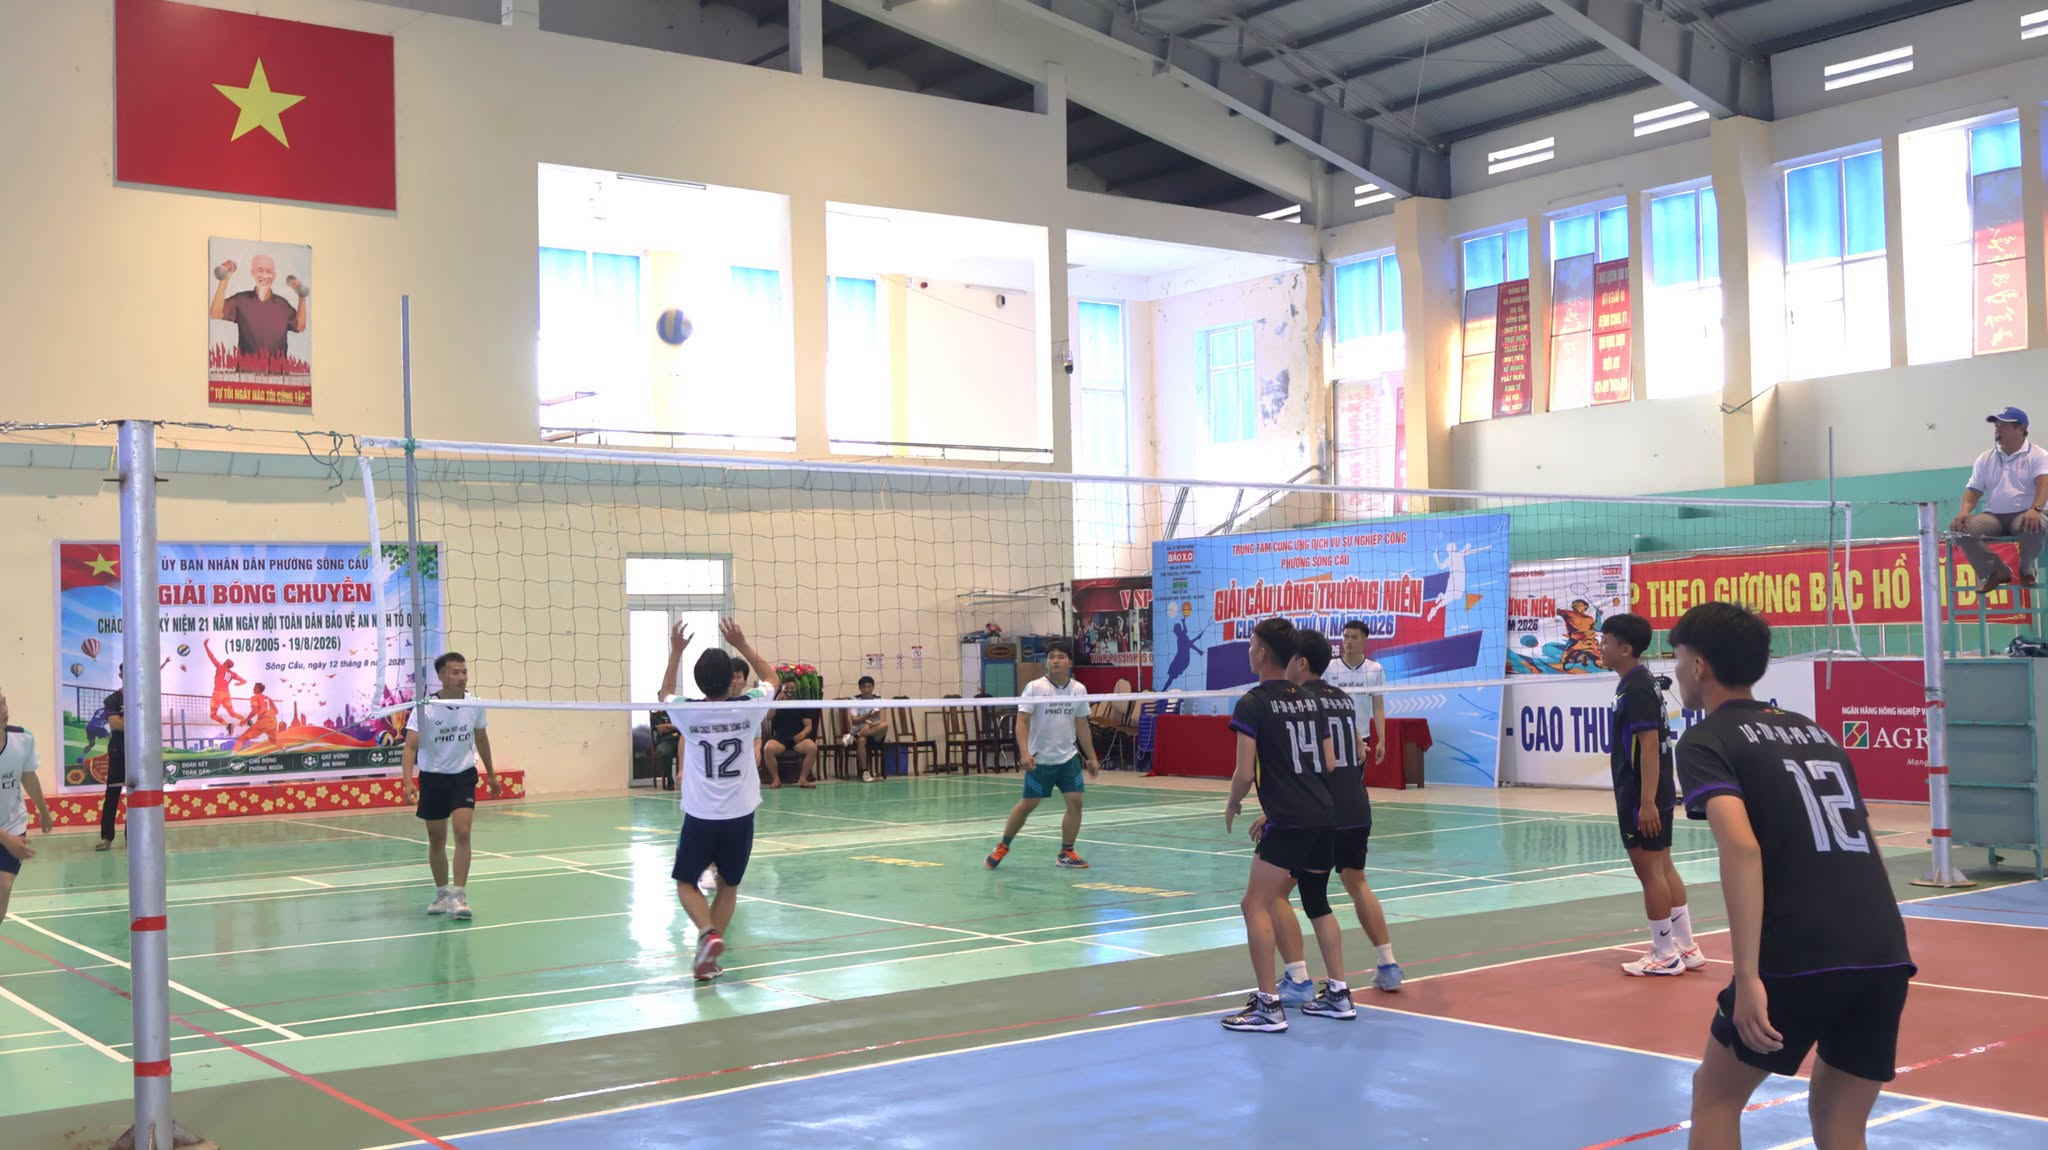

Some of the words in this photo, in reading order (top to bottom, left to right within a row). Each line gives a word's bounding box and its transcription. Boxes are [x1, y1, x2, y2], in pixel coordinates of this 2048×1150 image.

[235, 386, 251, 400] NGÀY
[1232, 543, 1254, 556] TRUNG
[1273, 540, 1292, 552] CUNG
[1354, 532, 1383, 547] NGHIỆP
[1384, 531, 1406, 544] CÔNG
[162, 556, 176, 570] ỦY
[181, 559, 203, 570] BAN
[208, 556, 238, 570] NHÂN
[243, 556, 265, 570] DÂN
[270, 556, 312, 570] PHƯỜNG
[316, 556, 344, 570] SÔNG
[348, 556, 368, 570] CẦU
[158, 578, 206, 606] GIẢI
[212, 580, 276, 605] BÓNG
[283, 576, 372, 604] CHUYỀN
[1214, 578, 1242, 622] GIẢI
[1245, 578, 1273, 616] CẦU
[1276, 580, 1315, 613] LÔNG
[1318, 576, 1379, 612] THƯỜNG
[1382, 572, 1424, 616] NIÊN
[1647, 578, 1706, 618] THEO
[1714, 571, 1801, 614] GƯƠNG
[1809, 562, 1864, 612] BÁC
[1872, 553, 1911, 609] HỒ
[1531, 594, 1555, 618] NIÊN
[172, 614, 196, 635] NIỆM
[200, 617, 209, 632] 21
[213, 613, 233, 631] NĂM
[236, 613, 259, 631] NGÀY
[262, 612, 276, 633] HỘI
[280, 612, 302, 630] TOÀN
[305, 612, 322, 630] DÂN
[326, 610, 342, 629] BẢO
[345, 612, 355, 631] VỆ
[358, 614, 369, 628] AN
[372, 613, 391, 628] NH
[1518, 620, 1538, 631] 2026
[225, 638, 279, 654] (19/8/2005
[289, 636, 341, 652] 19/8/2026)
[265, 662, 286, 671] Sông
[308, 661, 327, 670] ngày
[330, 660, 338, 668] 12
[340, 660, 362, 668] tháng
[364, 659, 369, 667] 8
[388, 658, 405, 666] 2026
[1842, 706, 1859, 715] NGÂN
[1860, 706, 1878, 715] HÀNG
[1879, 706, 1896, 715] NÔNG
[1897, 706, 1921, 717] NGHIỆP
[1521, 706, 1563, 753] CAO
[1873, 727, 1929, 749] AGR
[699, 738, 743, 778] 12
[1286, 720, 1322, 774] 14
[1907, 758, 1928, 767] Mang
[1782, 759, 1870, 853] 12
